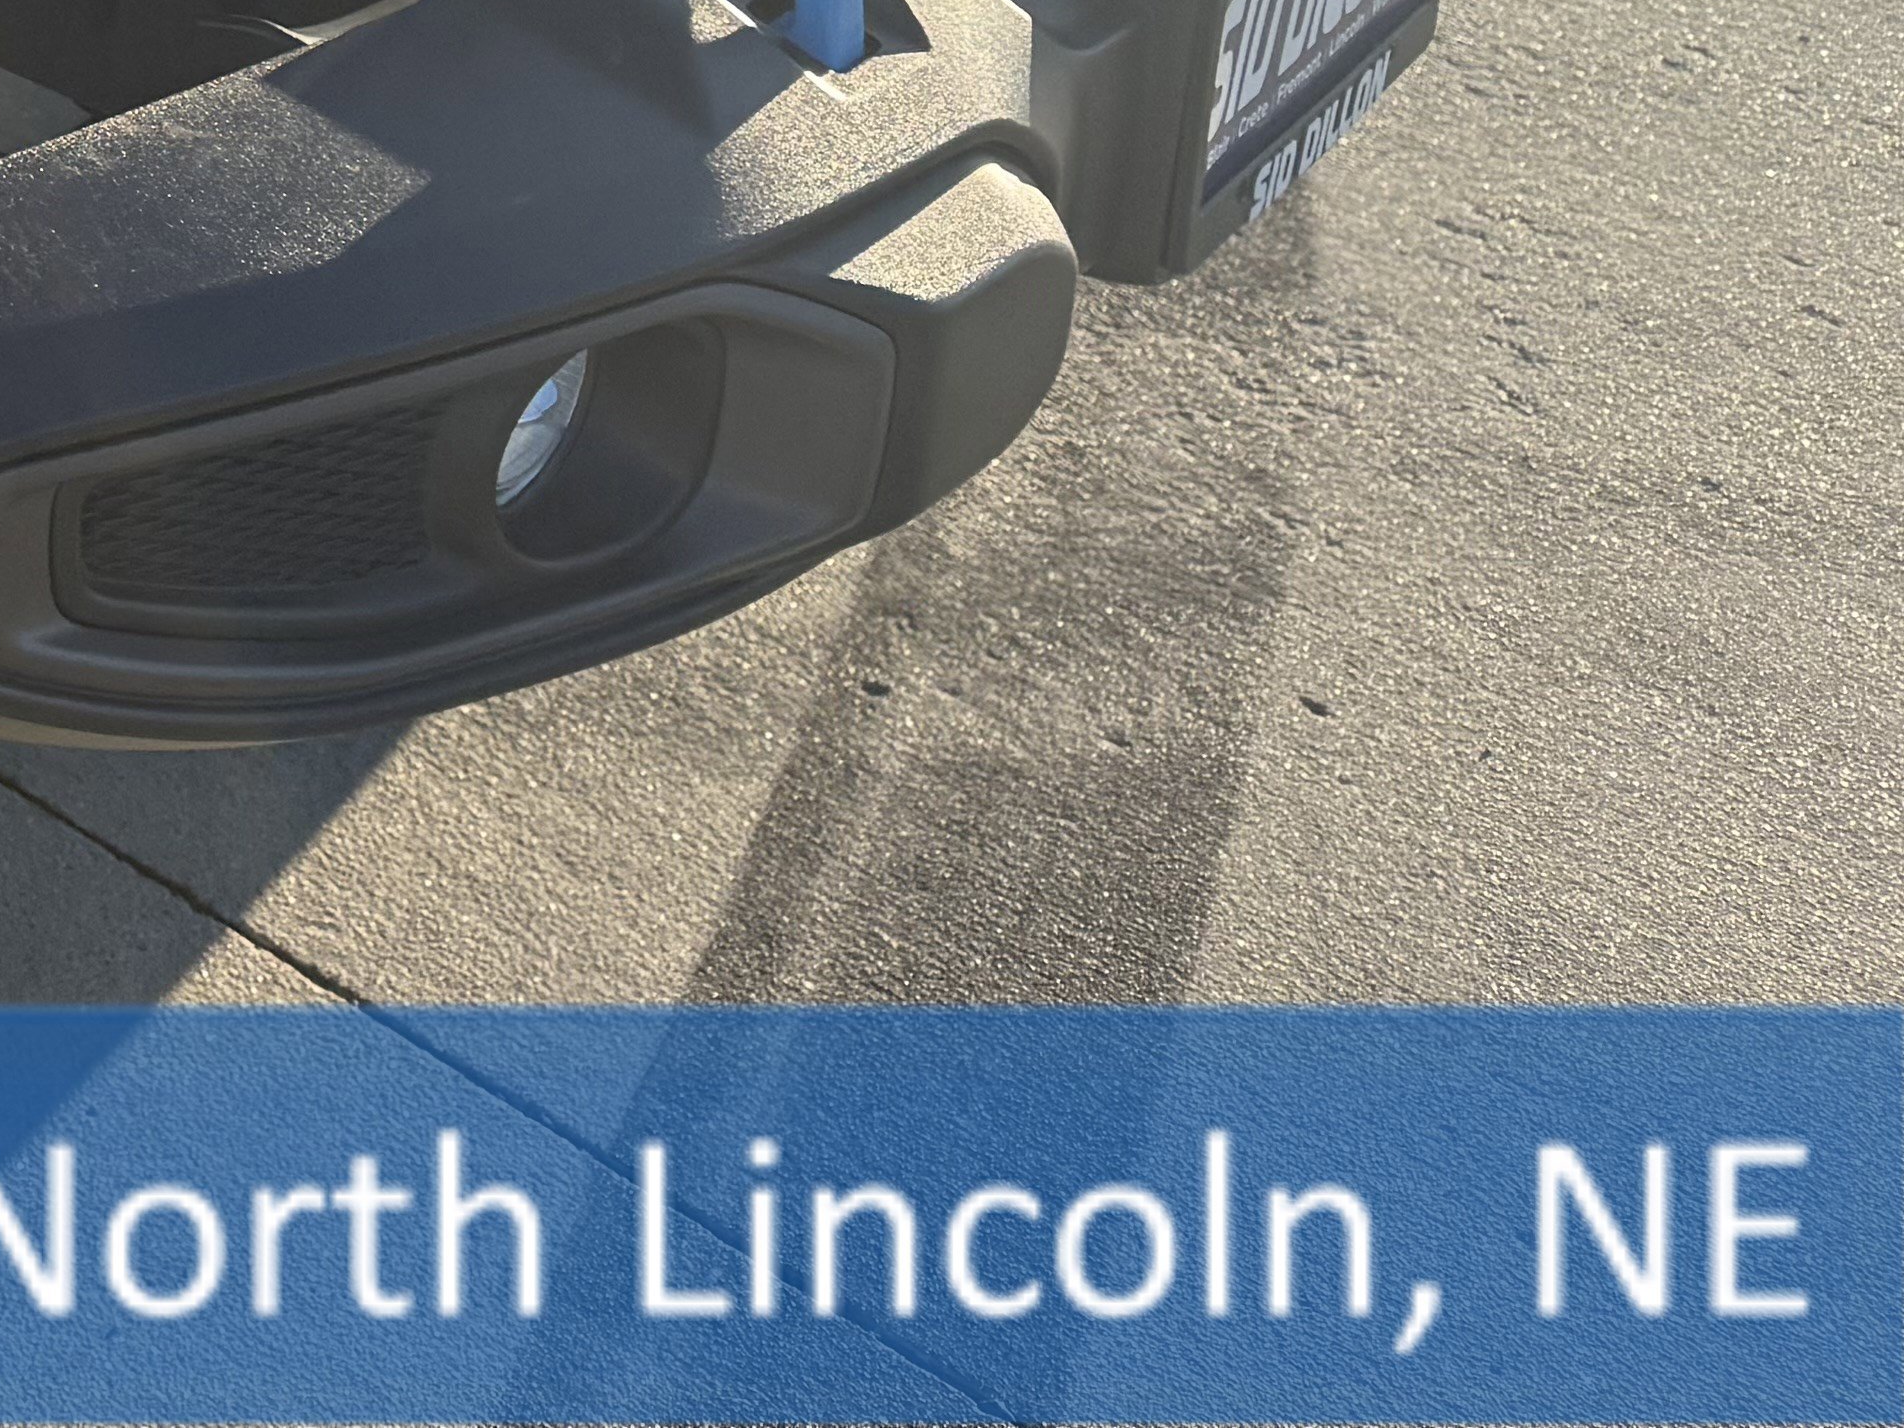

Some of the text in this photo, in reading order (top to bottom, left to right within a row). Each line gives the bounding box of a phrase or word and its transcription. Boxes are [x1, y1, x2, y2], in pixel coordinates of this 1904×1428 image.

[1238, 101, 1269, 137] Crete
[1277, 51, 1322, 104] Fremont
[1329, 13, 1365, 56] Lincoln
[1249, 50, 1391, 221] SID DILLON
